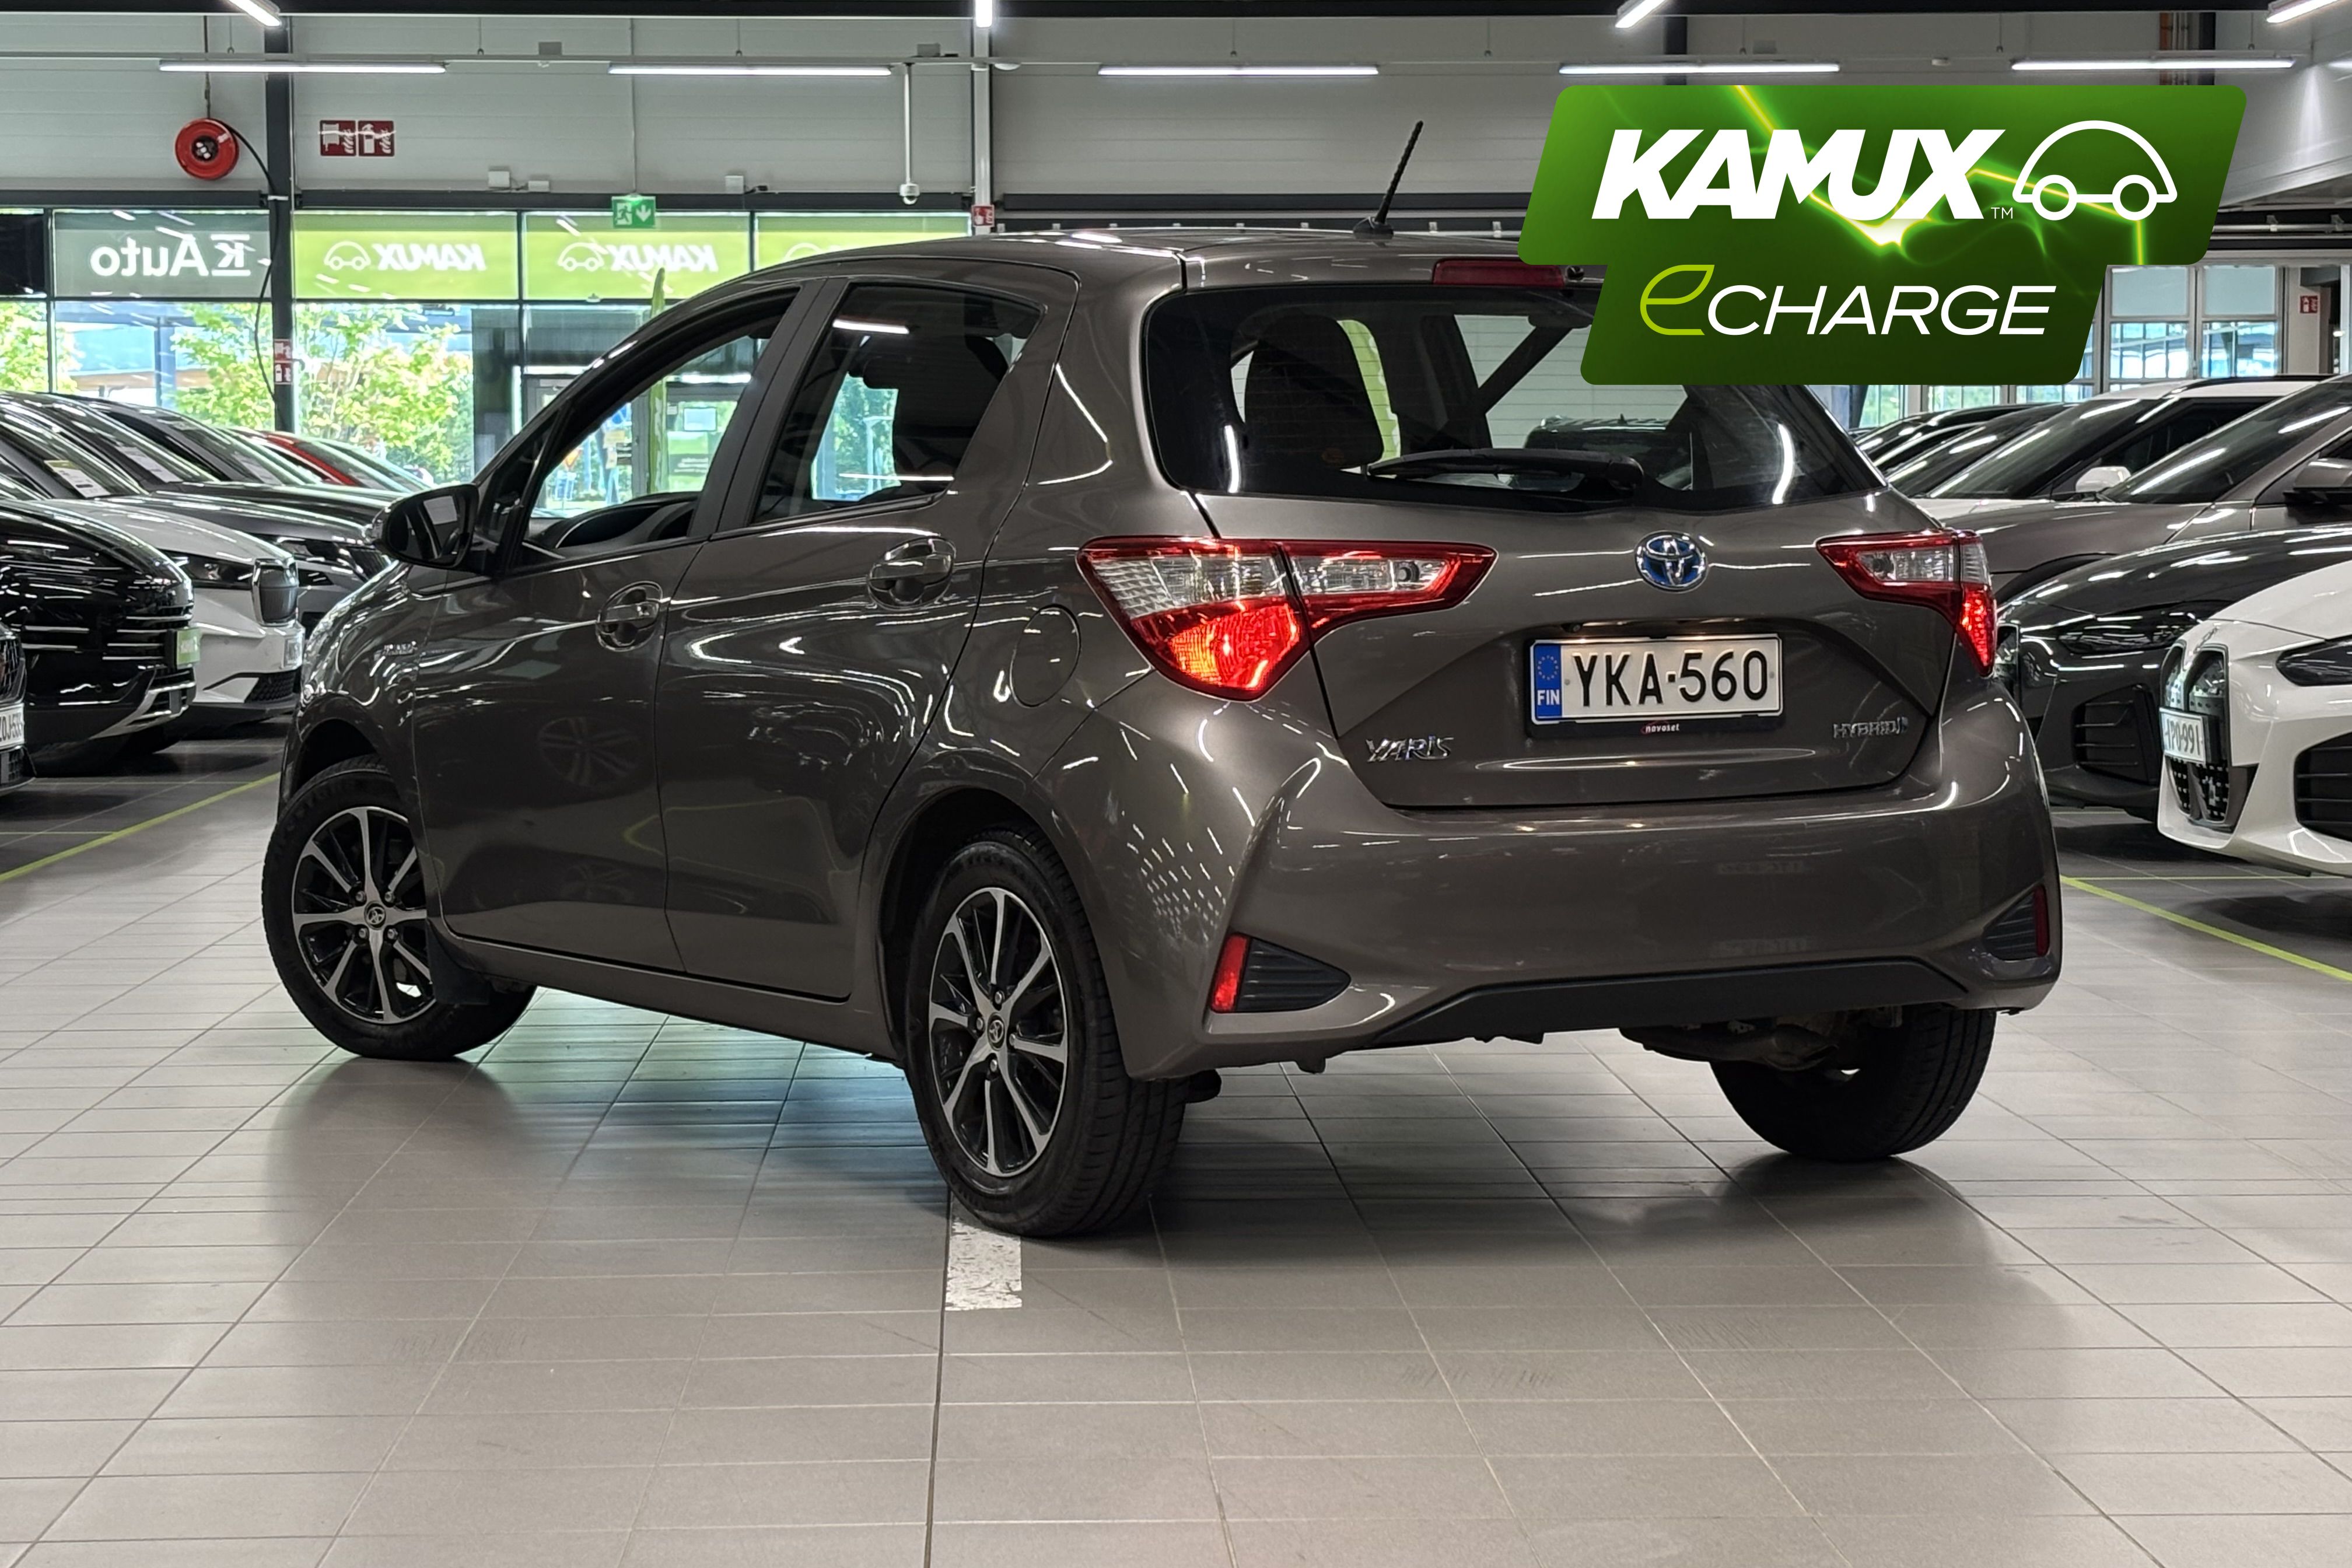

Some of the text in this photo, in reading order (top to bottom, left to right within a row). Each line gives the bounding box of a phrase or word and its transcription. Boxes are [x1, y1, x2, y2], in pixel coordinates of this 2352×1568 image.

[1572, 649, 1769, 707] YKA-560
[1537, 690, 1560, 705] FIN
[1833, 720, 1896, 738] HYBRID
[1366, 735, 1454, 762] YARIS
